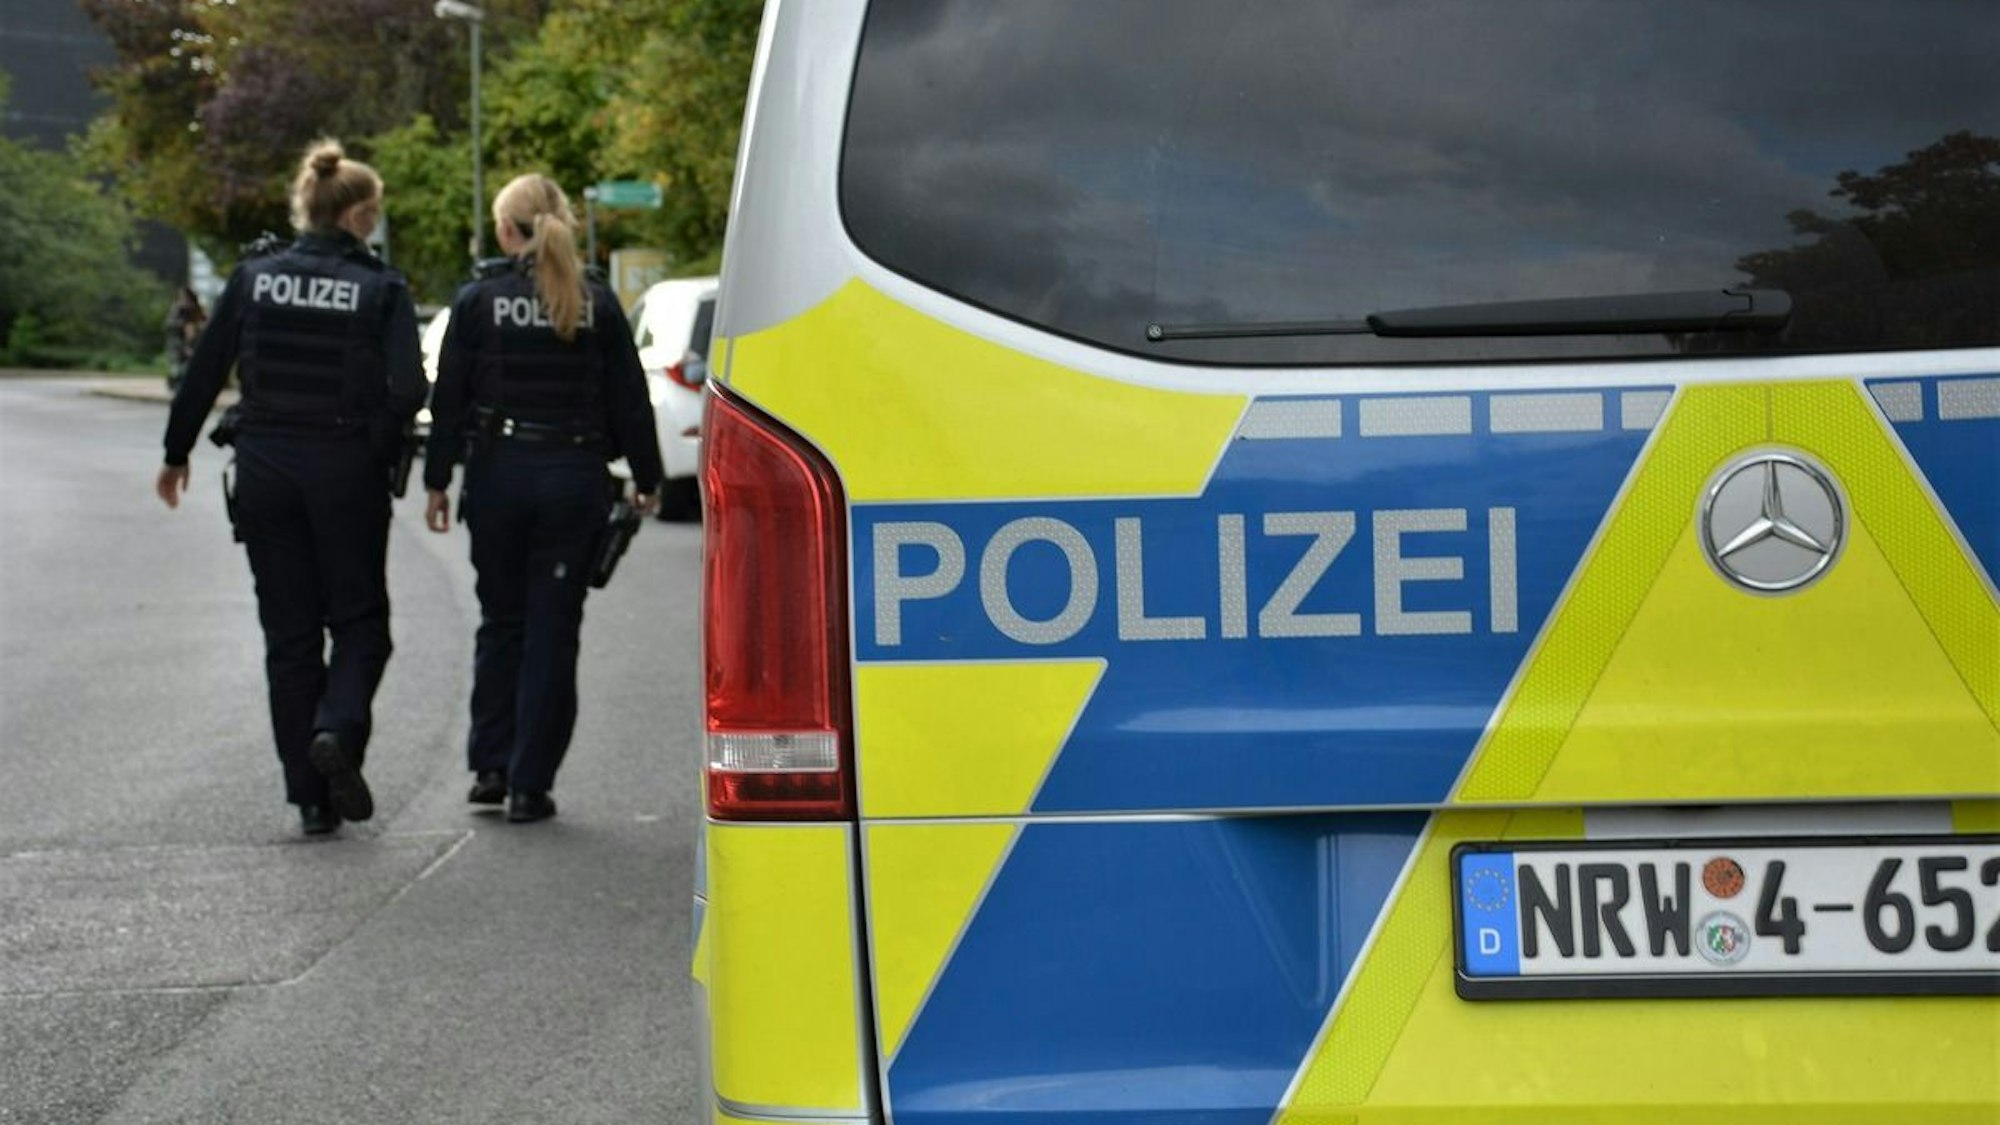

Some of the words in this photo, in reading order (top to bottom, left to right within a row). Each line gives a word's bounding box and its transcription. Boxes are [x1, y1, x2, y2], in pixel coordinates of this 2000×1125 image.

[253, 274, 359, 311] POLIZEI
[493, 296, 594, 328] POLI
[873, 507, 1518, 646] POLIZEI
[1518, 863, 1691, 958] NRW
[1480, 928, 1501, 955] D
